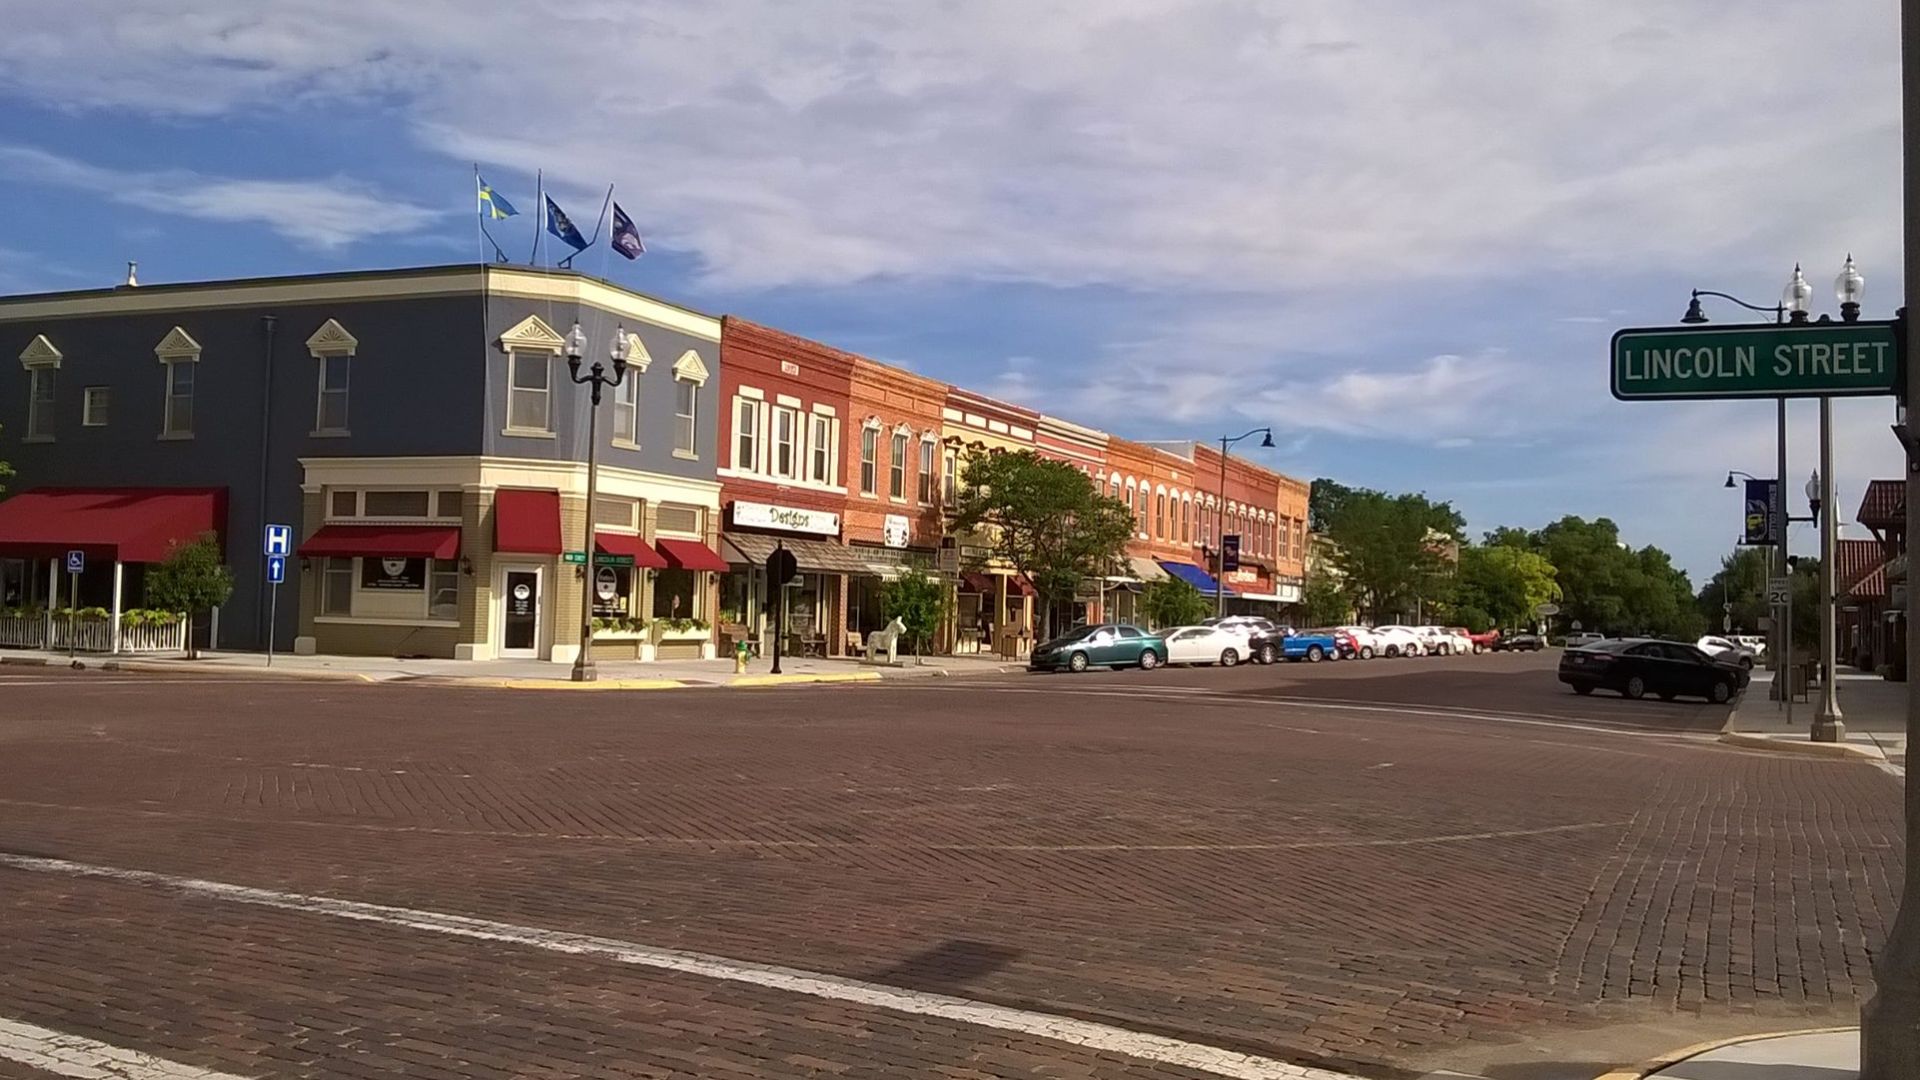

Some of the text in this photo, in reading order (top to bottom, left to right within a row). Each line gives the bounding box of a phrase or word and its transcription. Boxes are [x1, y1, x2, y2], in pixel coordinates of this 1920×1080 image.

[1625, 342, 1889, 381] LINCOLN STREET
[769, 507, 809, 529] Designs
[268, 527, 287, 553] H
[1770, 591, 1788, 603] 20
